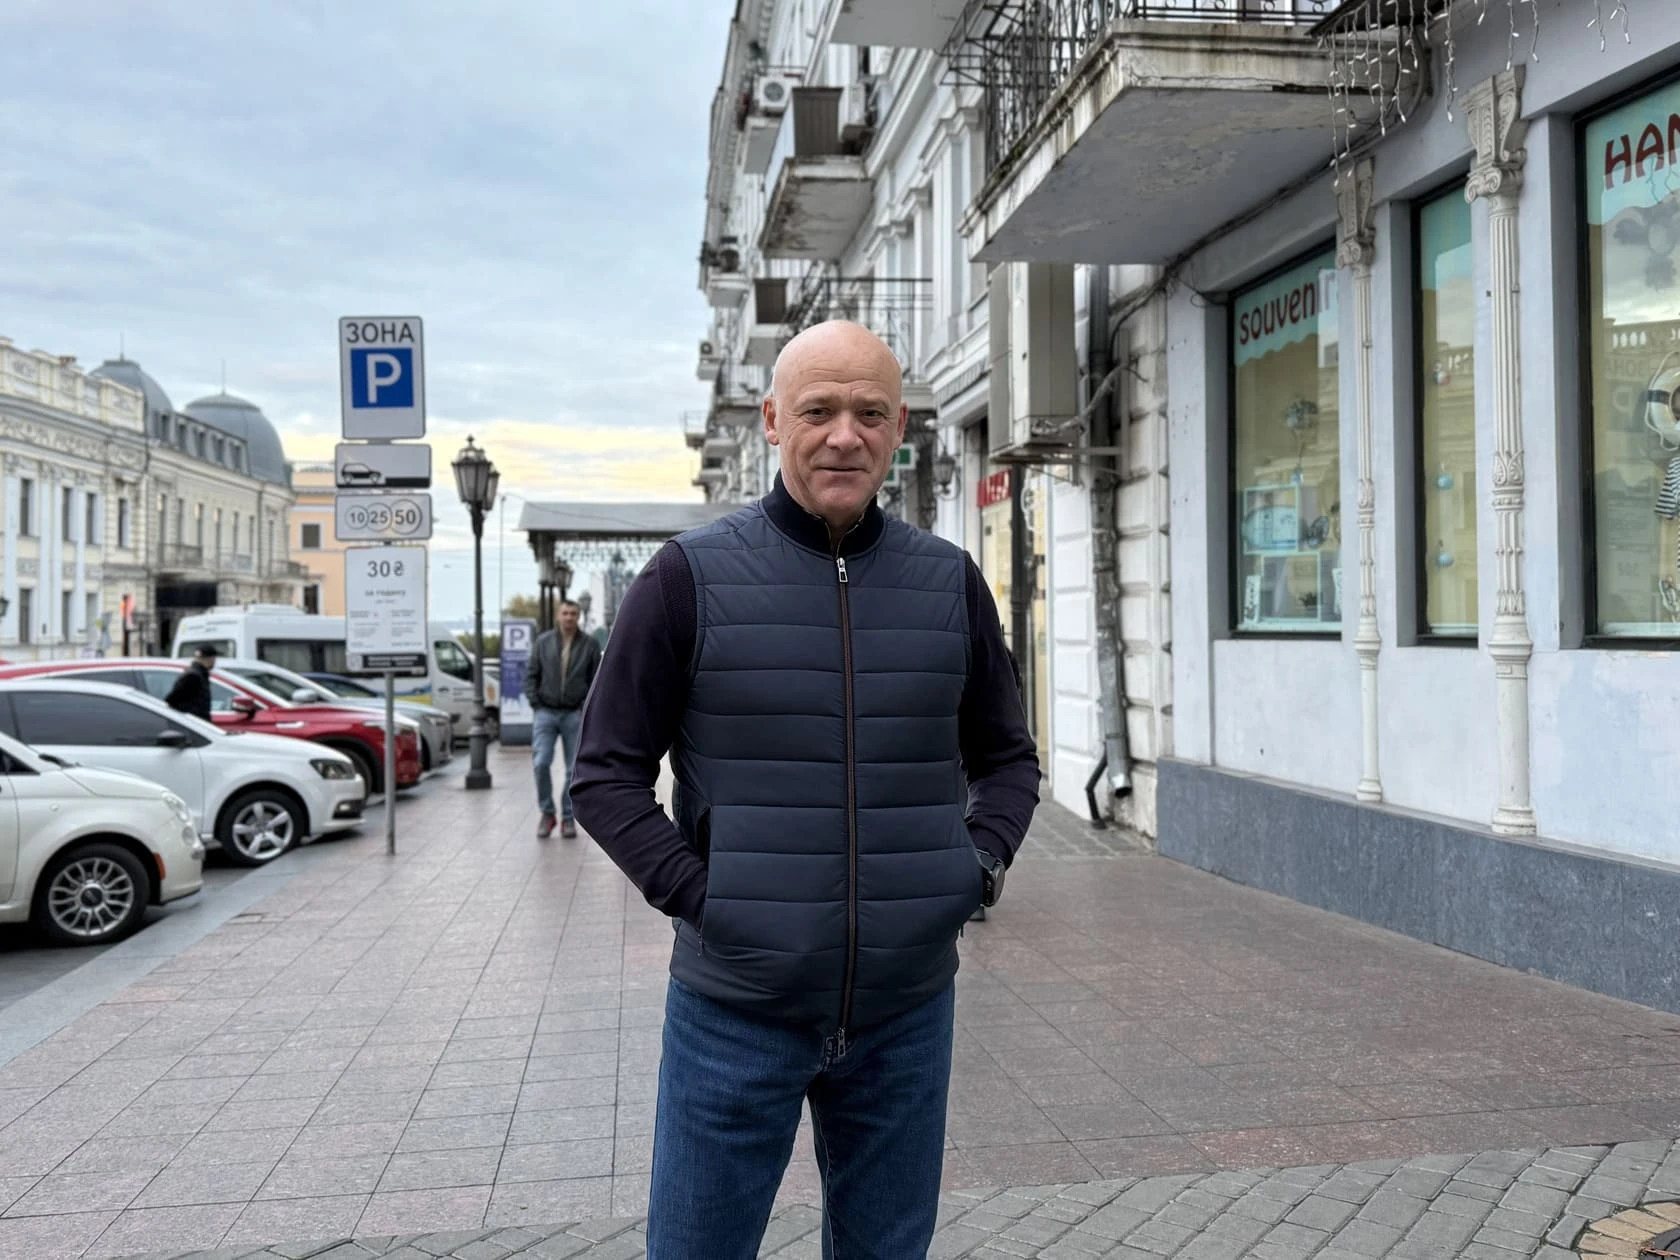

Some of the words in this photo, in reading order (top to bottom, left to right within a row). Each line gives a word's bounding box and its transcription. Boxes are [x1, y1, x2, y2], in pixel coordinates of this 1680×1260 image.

[1239, 266, 1340, 345] souvenir
[346, 322, 415, 343] ЗОНА
[366, 353, 402, 404] P
[350, 512, 365, 523] 10
[369, 511, 388, 524] 25
[395, 509, 416, 525] 50
[509, 628, 526, 648] P
